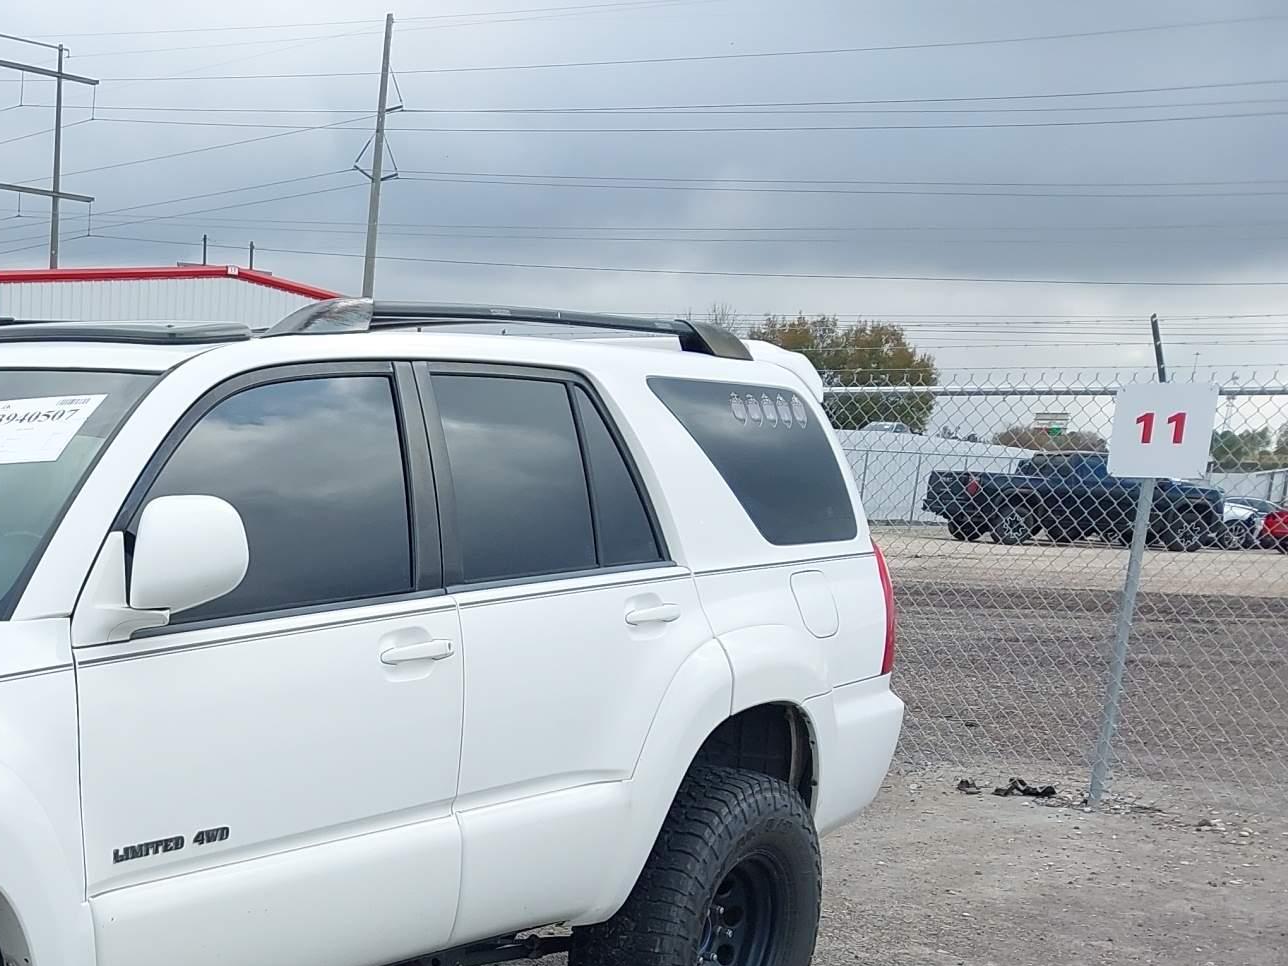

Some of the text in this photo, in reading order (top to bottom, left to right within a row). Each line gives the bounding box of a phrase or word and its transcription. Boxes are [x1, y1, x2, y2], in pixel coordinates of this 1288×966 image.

[1135, 412, 1187, 445] 11
[112, 826, 230, 864] LIMITED 4WD
